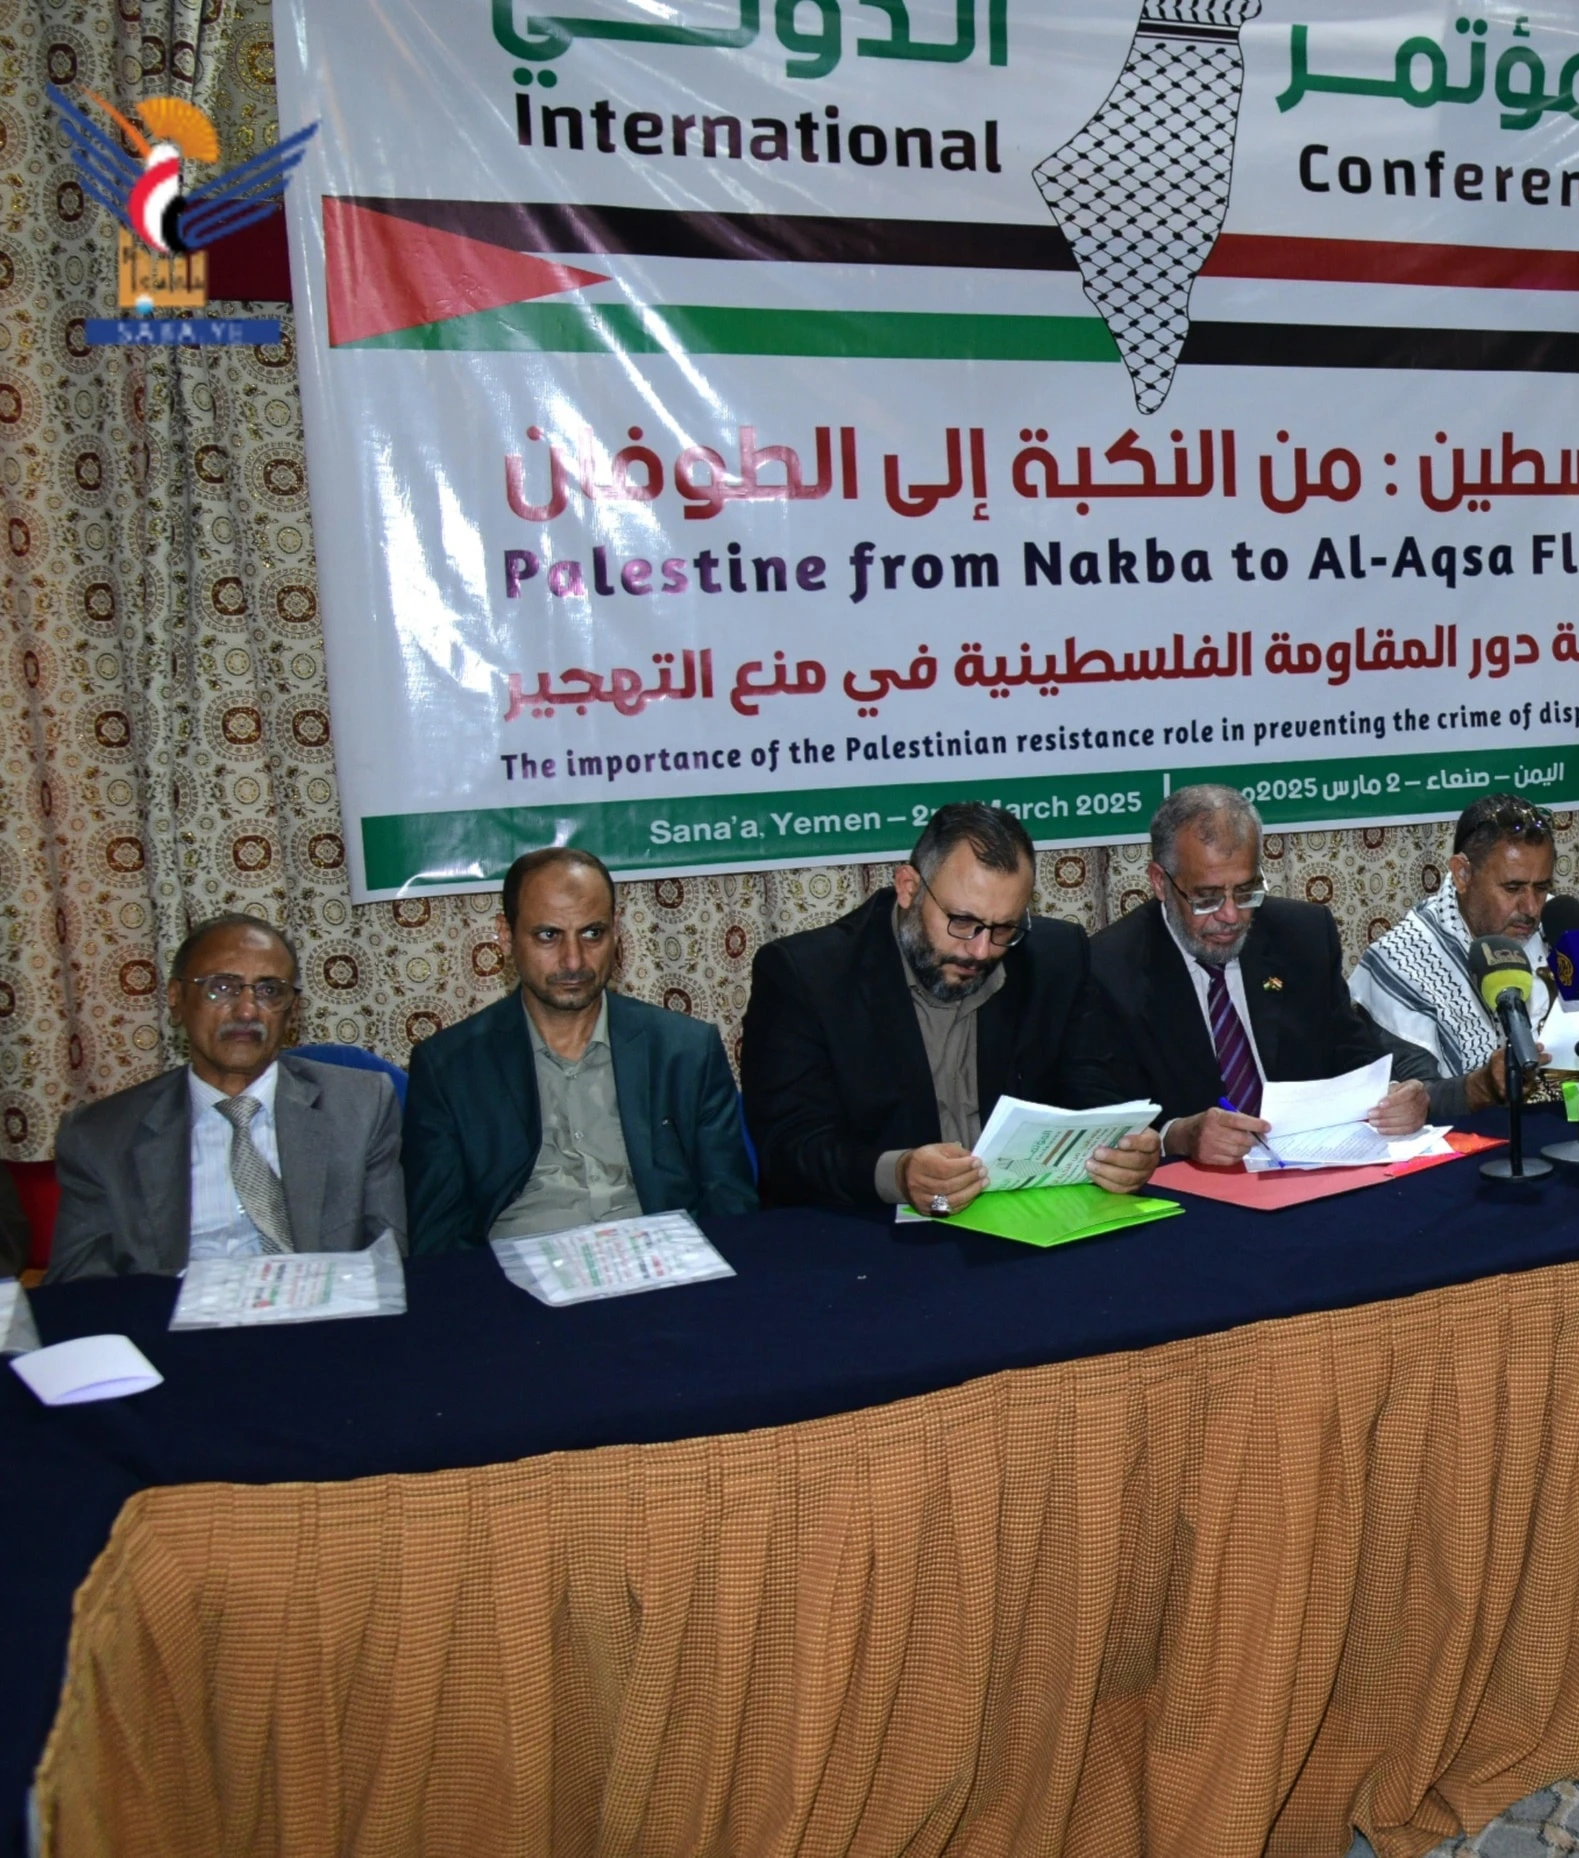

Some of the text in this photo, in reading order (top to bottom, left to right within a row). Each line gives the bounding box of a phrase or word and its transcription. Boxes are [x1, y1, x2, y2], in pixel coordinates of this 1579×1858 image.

[515, 92, 1002, 174] International
[505, 426, 856, 521] الطوفان
[884, 428, 989, 521] إلى
[1011, 428, 1237, 516] النكبة
[1259, 429, 1361, 514] من
[503, 542, 827, 599] Palestine
[849, 542, 999, 604] from
[1023, 538, 1214, 588] Nakba
[1231, 541, 1289, 583] to
[1308, 534, 1514, 589] Al-Aqsa
[503, 648, 714, 722] التهجير
[729, 650, 827, 717] منع
[842, 644, 938, 718] في
[953, 631, 1253, 701] الفلسطينية
[1264, 624, 1457, 687] المقاومة
[1468, 631, 1540, 680] دور
[501, 752, 557, 781] The
[566, 746, 741, 782] importance
[750, 739, 781, 772] of
[789, 738, 836, 764] the
[846, 729, 1007, 761] Palestinian
[1016, 722, 1155, 751] resistance
[1163, 718, 1214, 747] role
[1221, 717, 1246, 743] in
[1254, 709, 1386, 746] preventing
[1393, 707, 1430, 733] the
[1437, 704, 1502, 730] crime
[1509, 702, 1534, 731] of
[1513, 762, 1564, 789] اليمن
[1322, 774, 1381, 801] مارس
[1386, 773, 1401, 793] 2
[1426, 768, 1490, 790] صنعاء
[771, 811, 881, 837] Yemen
[1076, 792, 1142, 815] 2025
